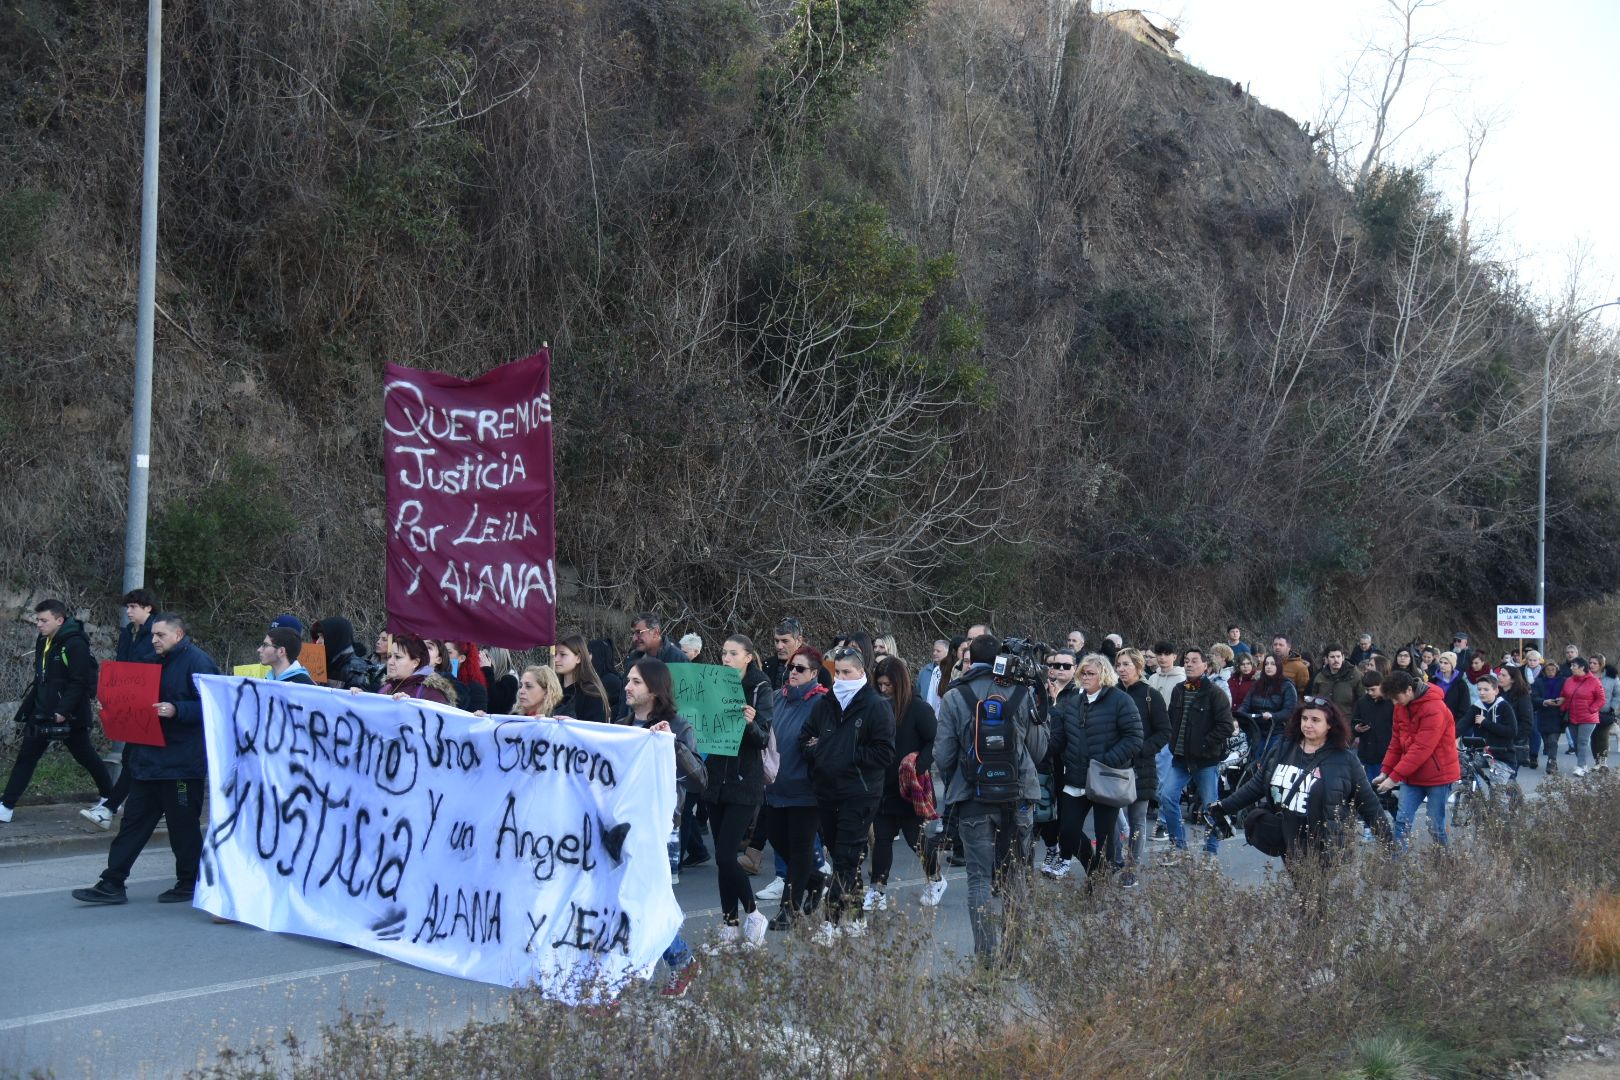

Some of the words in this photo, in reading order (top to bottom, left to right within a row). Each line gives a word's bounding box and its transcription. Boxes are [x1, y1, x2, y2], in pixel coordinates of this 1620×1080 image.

[384, 380, 551, 444] QUEREMOS
[394, 500, 445, 552] Por
[401, 558, 423, 596] Y
[418, 710, 481, 771] Una
[494, 720, 617, 788] Guerrera
[450, 821, 474, 850] un
[495, 790, 597, 880] Angel
[412, 883, 501, 944] ALANA
[525, 912, 547, 952] Y
